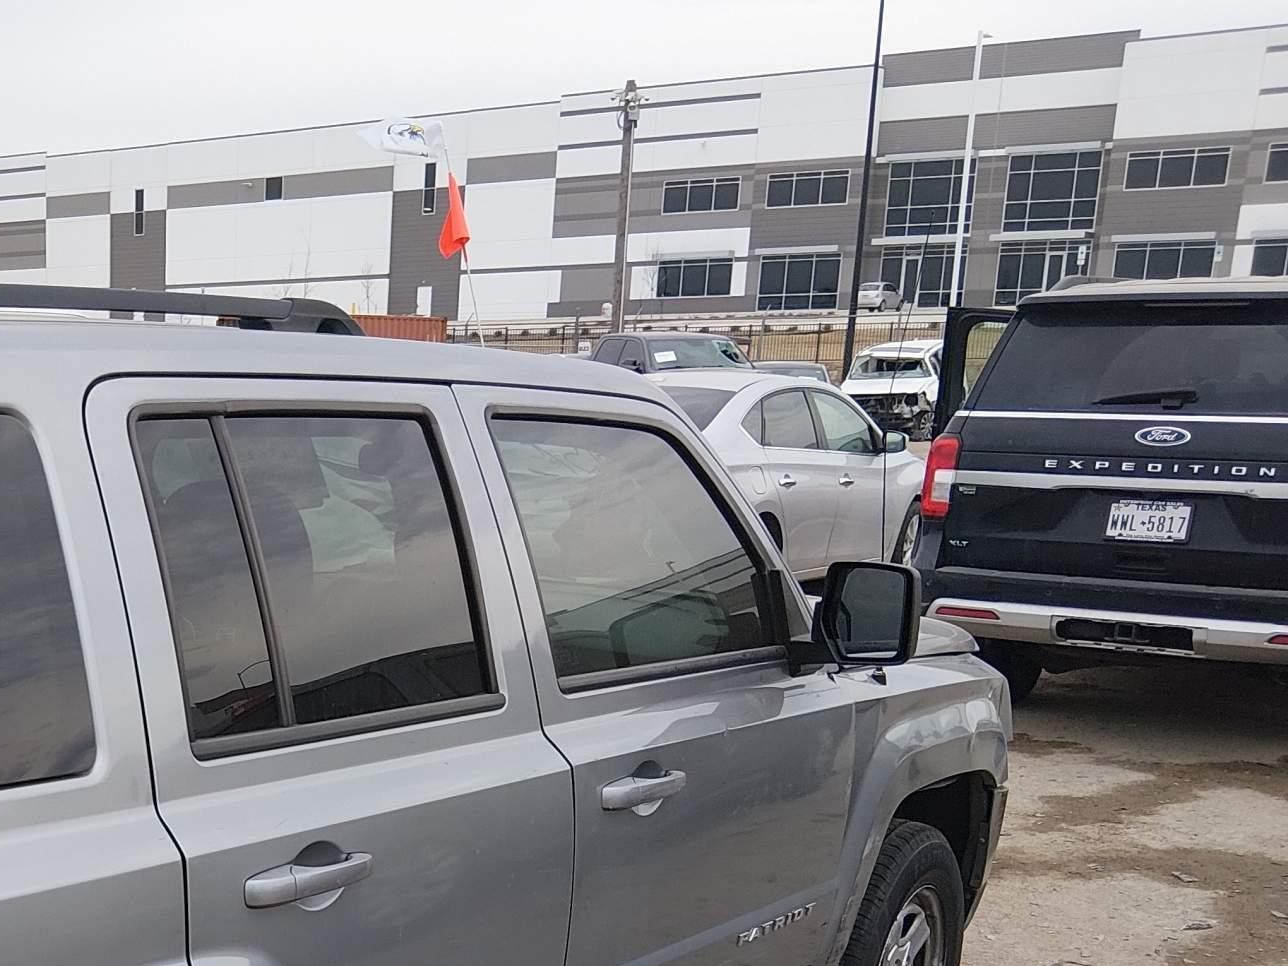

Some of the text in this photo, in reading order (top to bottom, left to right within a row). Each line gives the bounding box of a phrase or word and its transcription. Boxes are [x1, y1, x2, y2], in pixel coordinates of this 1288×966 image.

[1044, 458, 1277, 477] EXPEDITION
[1135, 503, 1168, 512] TEXAS
[1109, 513, 1187, 534] WWL 5817
[736, 901, 817, 948] PATRIOT
